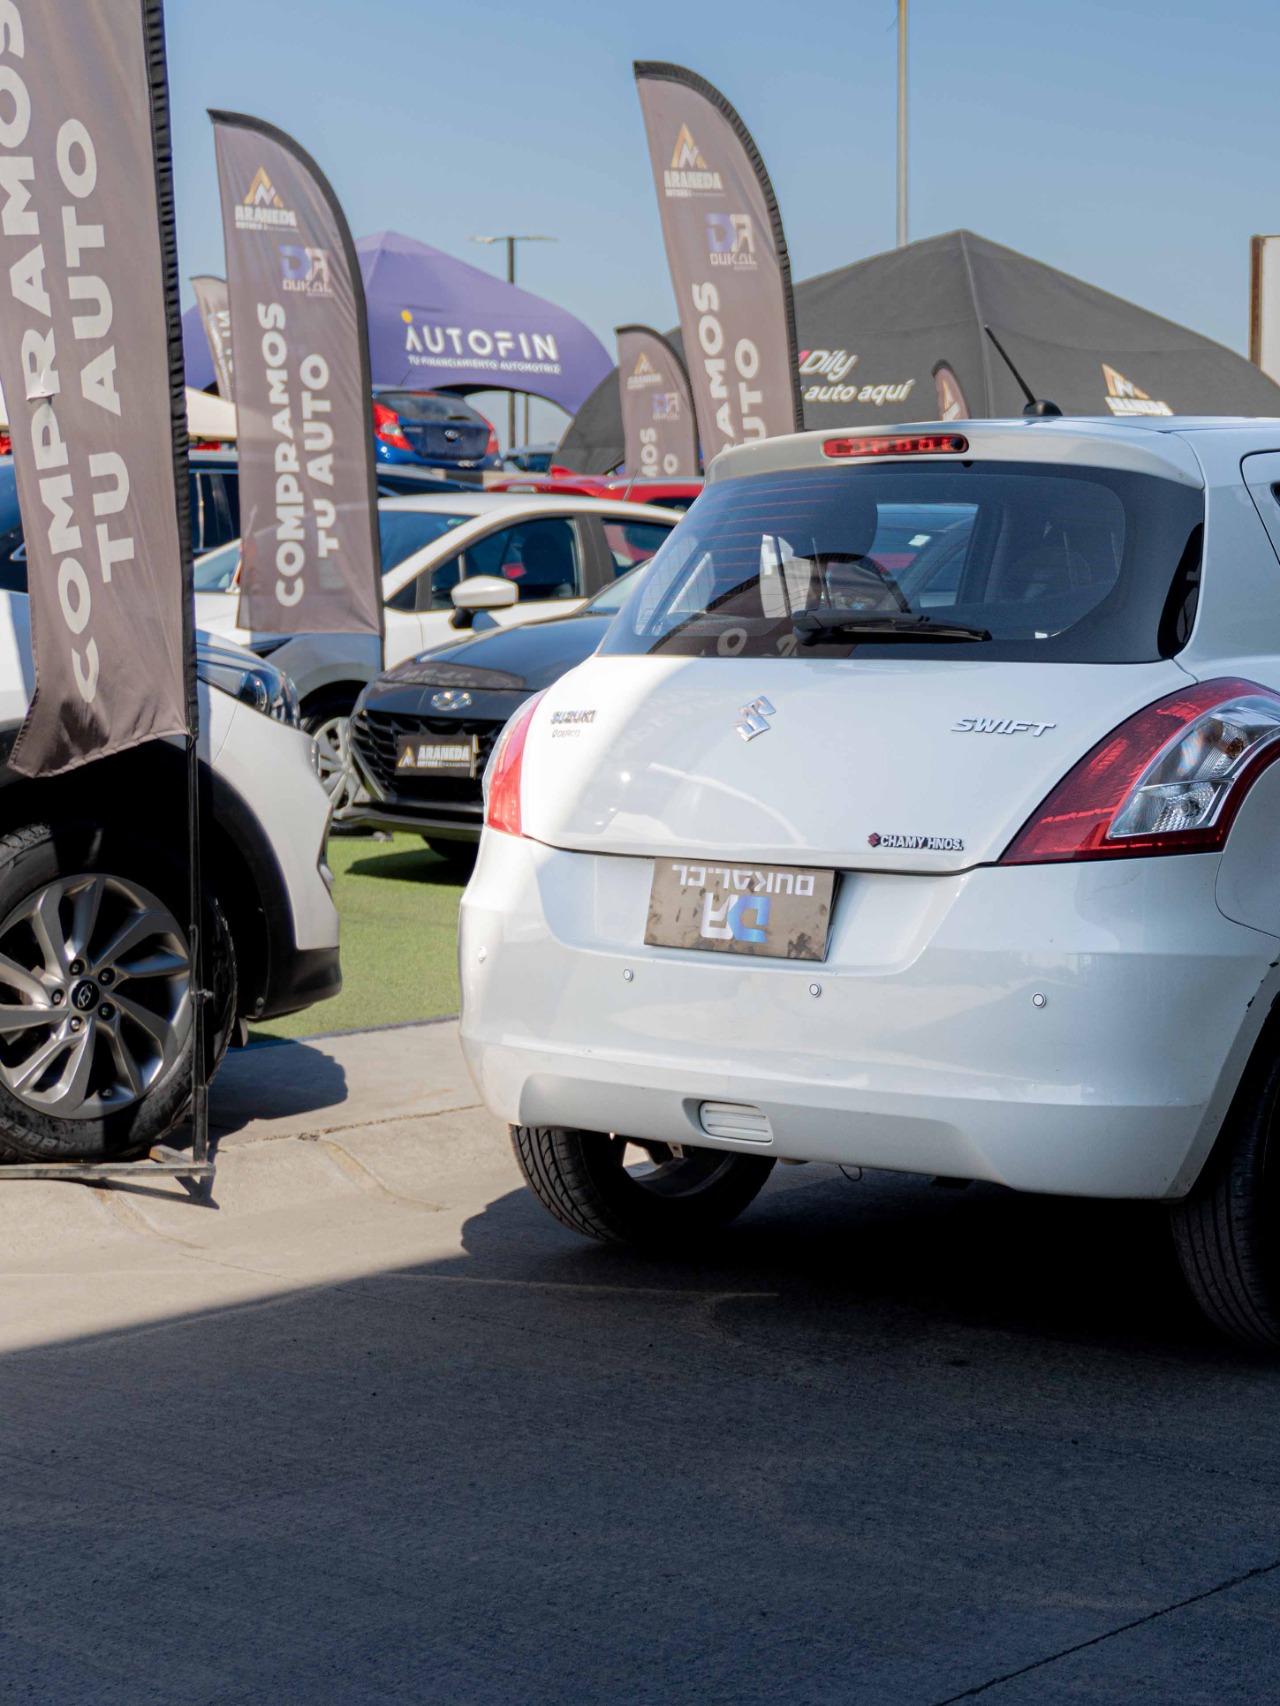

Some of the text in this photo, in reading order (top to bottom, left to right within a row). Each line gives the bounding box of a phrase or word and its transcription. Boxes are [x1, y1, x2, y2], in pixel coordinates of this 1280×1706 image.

[710, 252, 757, 266] DUKAL
[0, 0, 99, 703] COMPRAMOS
[56, 118, 135, 583] TU AUTO
[404, 325, 559, 361] AUTOFIN
[735, 338, 766, 444] UTO
[804, 378, 916, 406] auto aquí
[257, 302, 305, 607] COMPRAMOS
[300, 353, 340, 558] TU AUTO
[551, 709, 598, 725] SUZUKI
[951, 717, 1057, 737] SWIFT
[417, 745, 470, 761] ARANEDA
[880, 834, 964, 850] CHAMY HNOS.
[672, 864, 815, 897] DUKAL.CL
